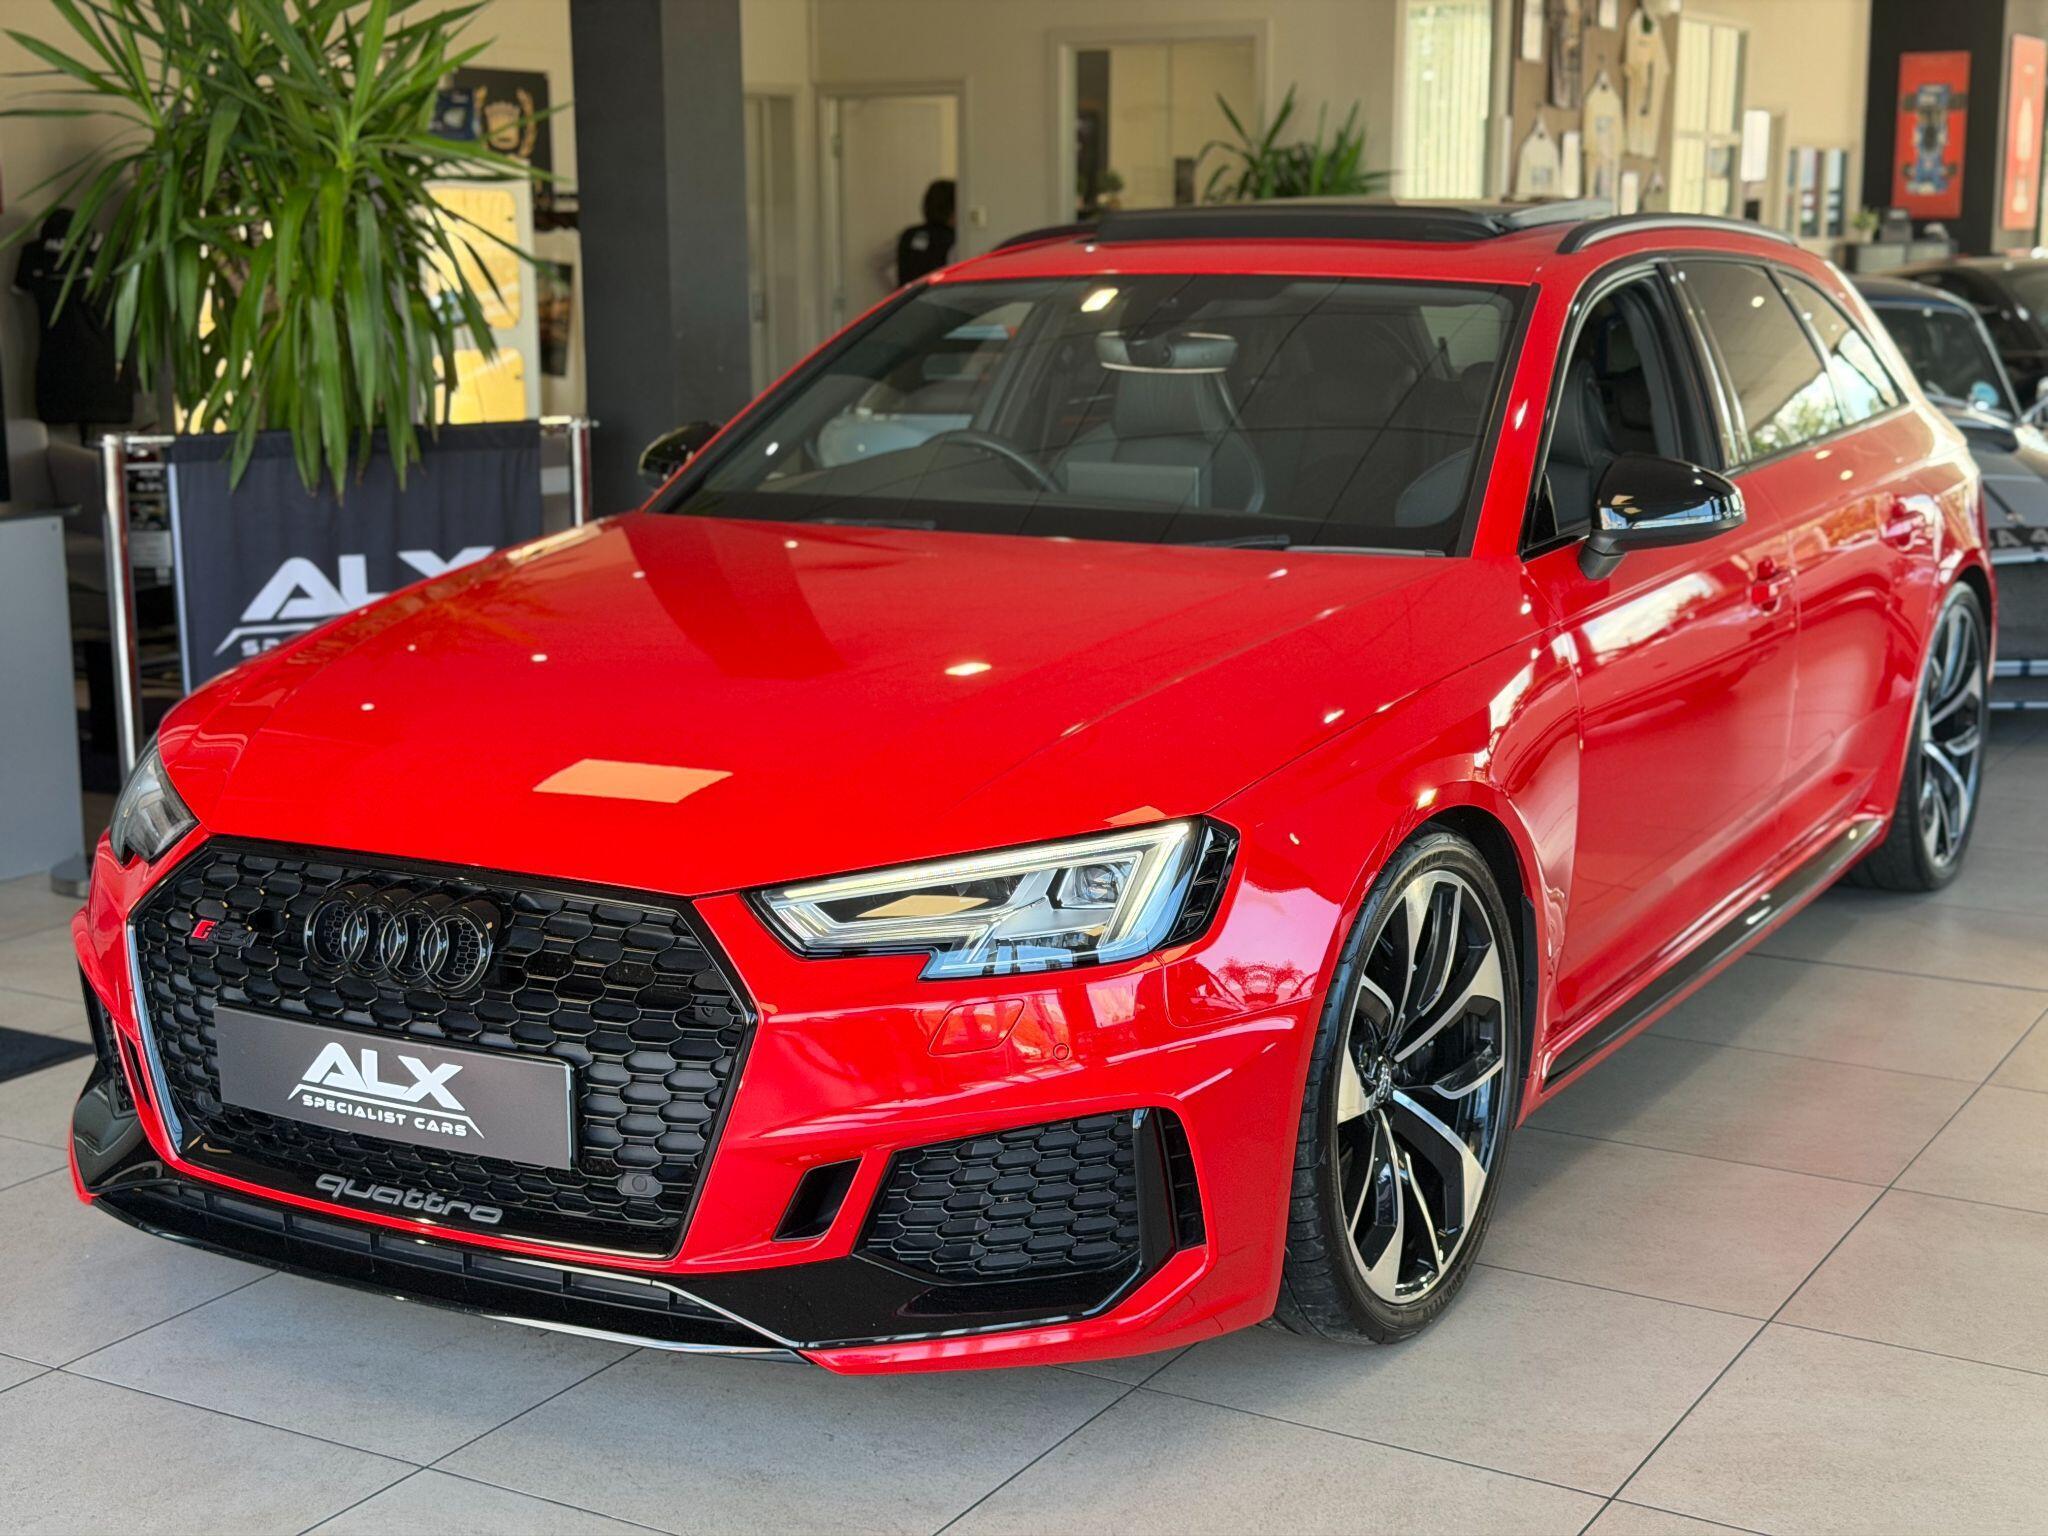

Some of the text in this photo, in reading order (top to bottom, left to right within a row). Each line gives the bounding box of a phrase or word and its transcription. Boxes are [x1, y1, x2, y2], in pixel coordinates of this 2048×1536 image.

[302, 1042, 466, 1112] ALX
[302, 1094, 468, 1137] SPECIALIST CARS
[315, 1173, 503, 1225] quattro
